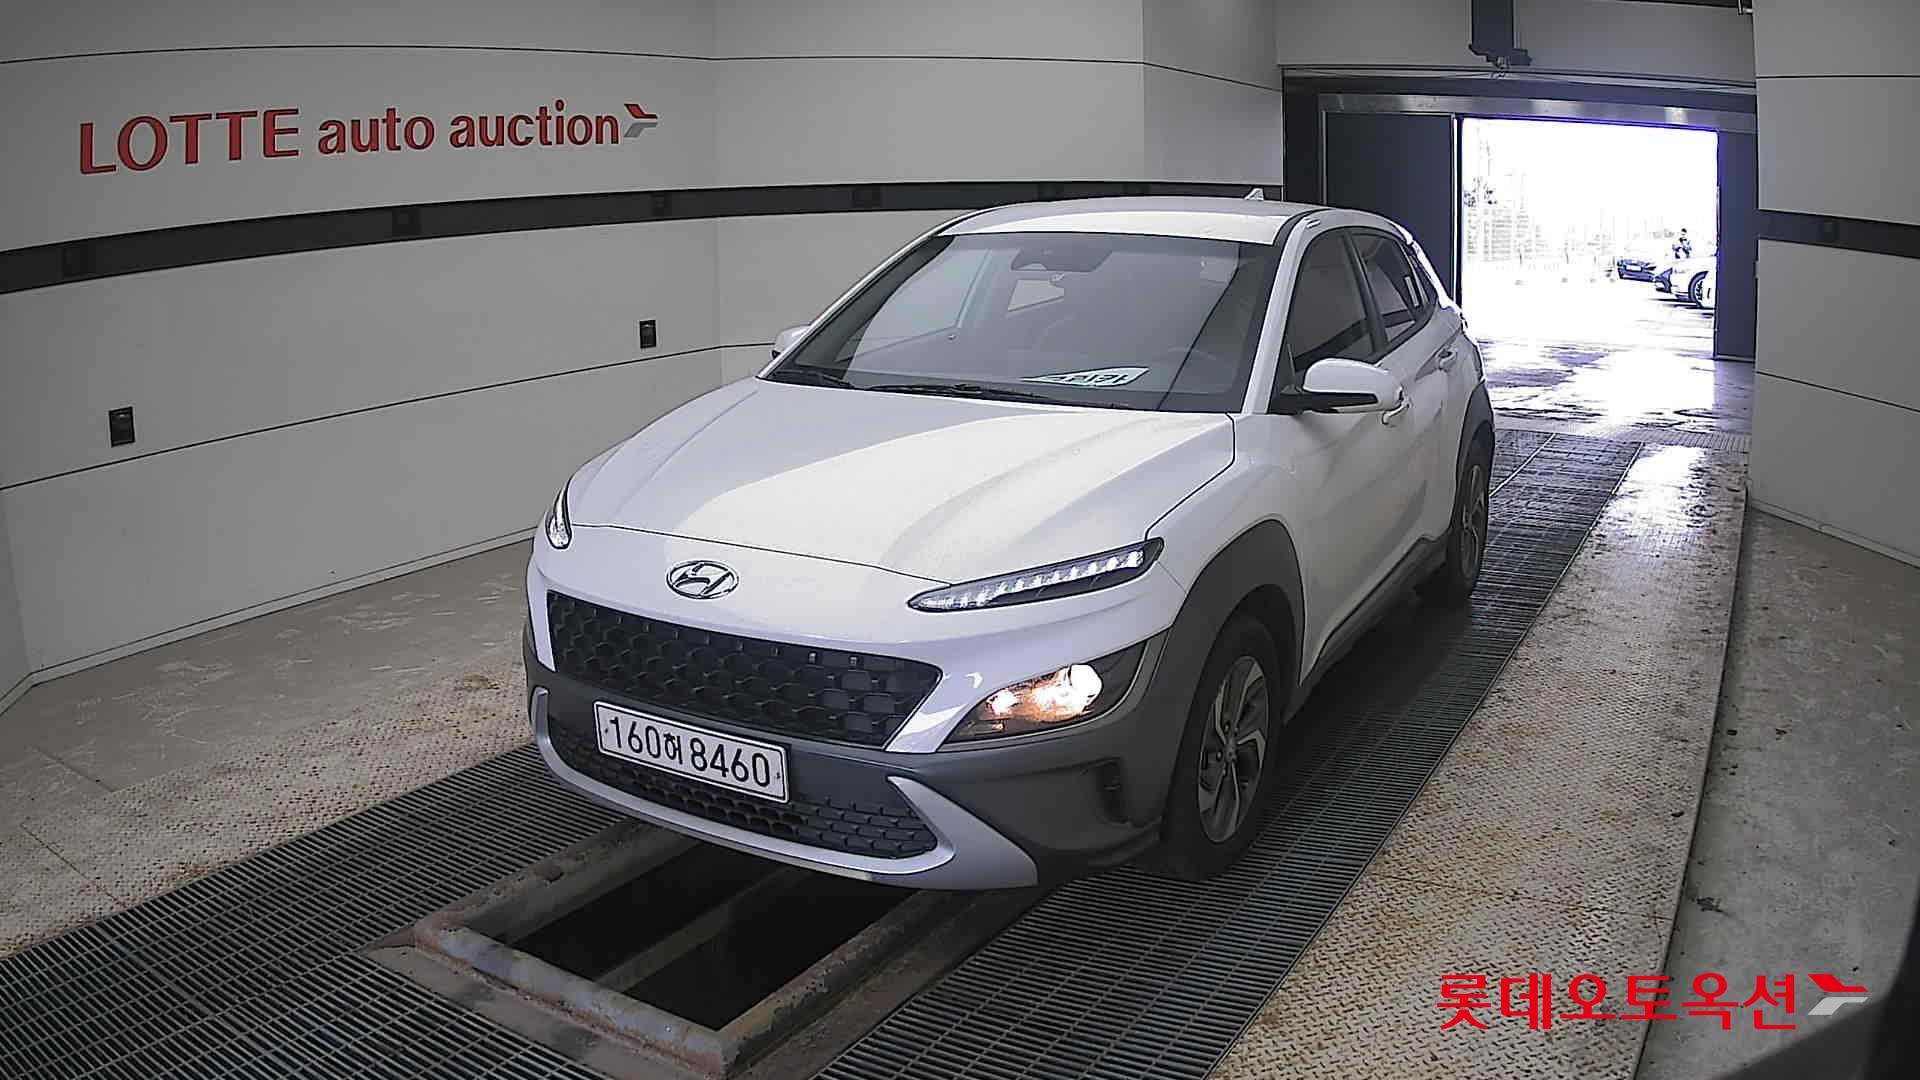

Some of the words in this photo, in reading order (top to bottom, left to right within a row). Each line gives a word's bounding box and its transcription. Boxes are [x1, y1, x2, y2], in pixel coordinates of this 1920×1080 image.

[79, 107, 299, 175] LOTTE
[317, 107, 435, 155] auto
[449, 99, 620, 148] auction
